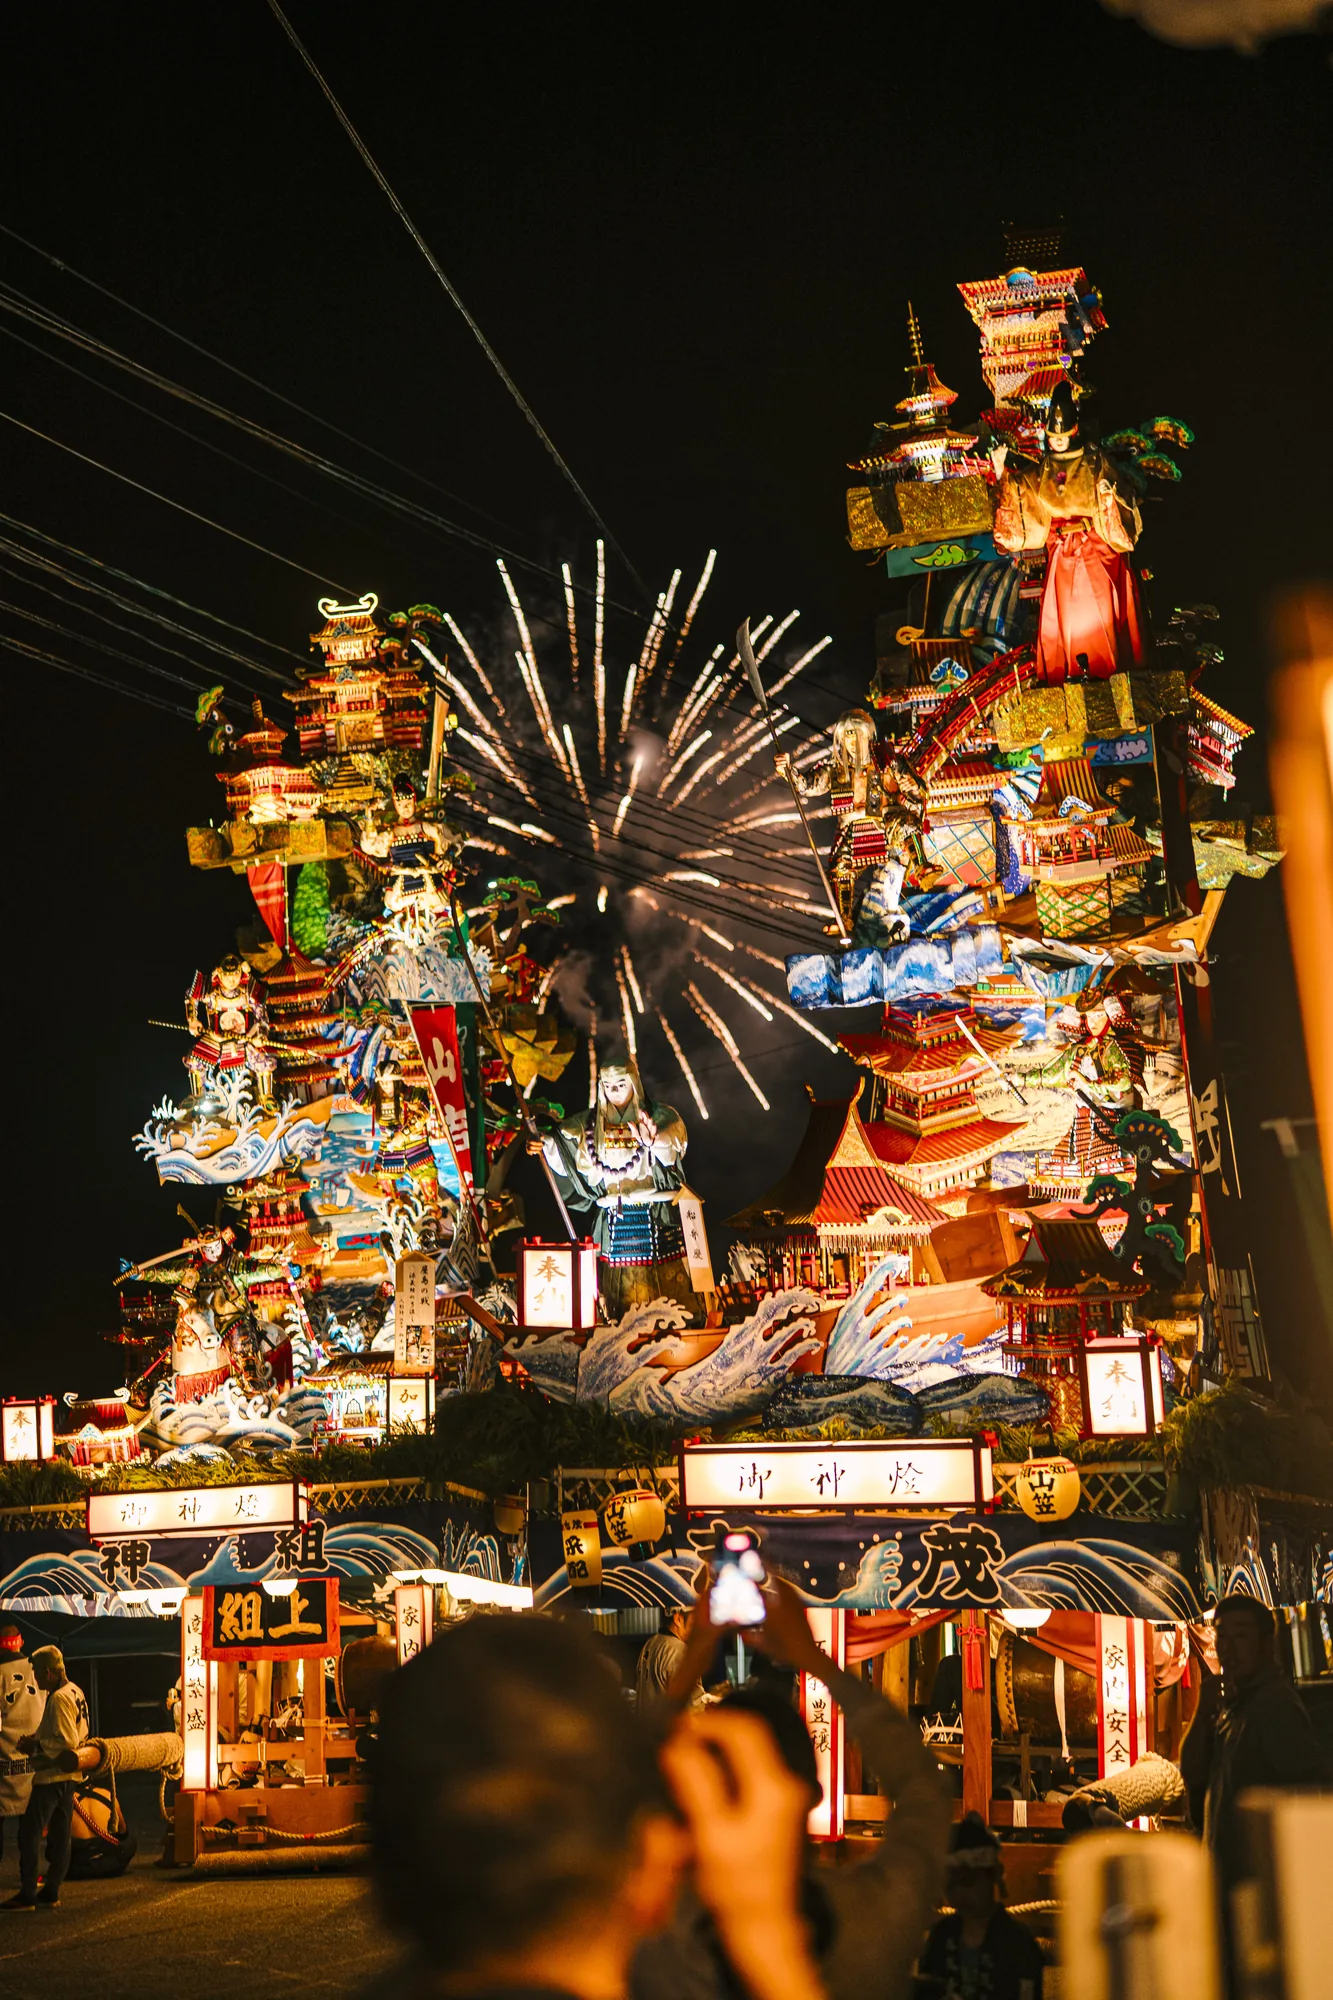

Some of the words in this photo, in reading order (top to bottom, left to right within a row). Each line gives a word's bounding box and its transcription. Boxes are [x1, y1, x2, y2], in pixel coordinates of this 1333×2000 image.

[738, 1461, 924, 1500] 御神燈
[1028, 1469, 1057, 1515] 山笠
[606, 1502, 633, 1543] 山笠
[1104, 1644, 1130, 1763] 家内安全
